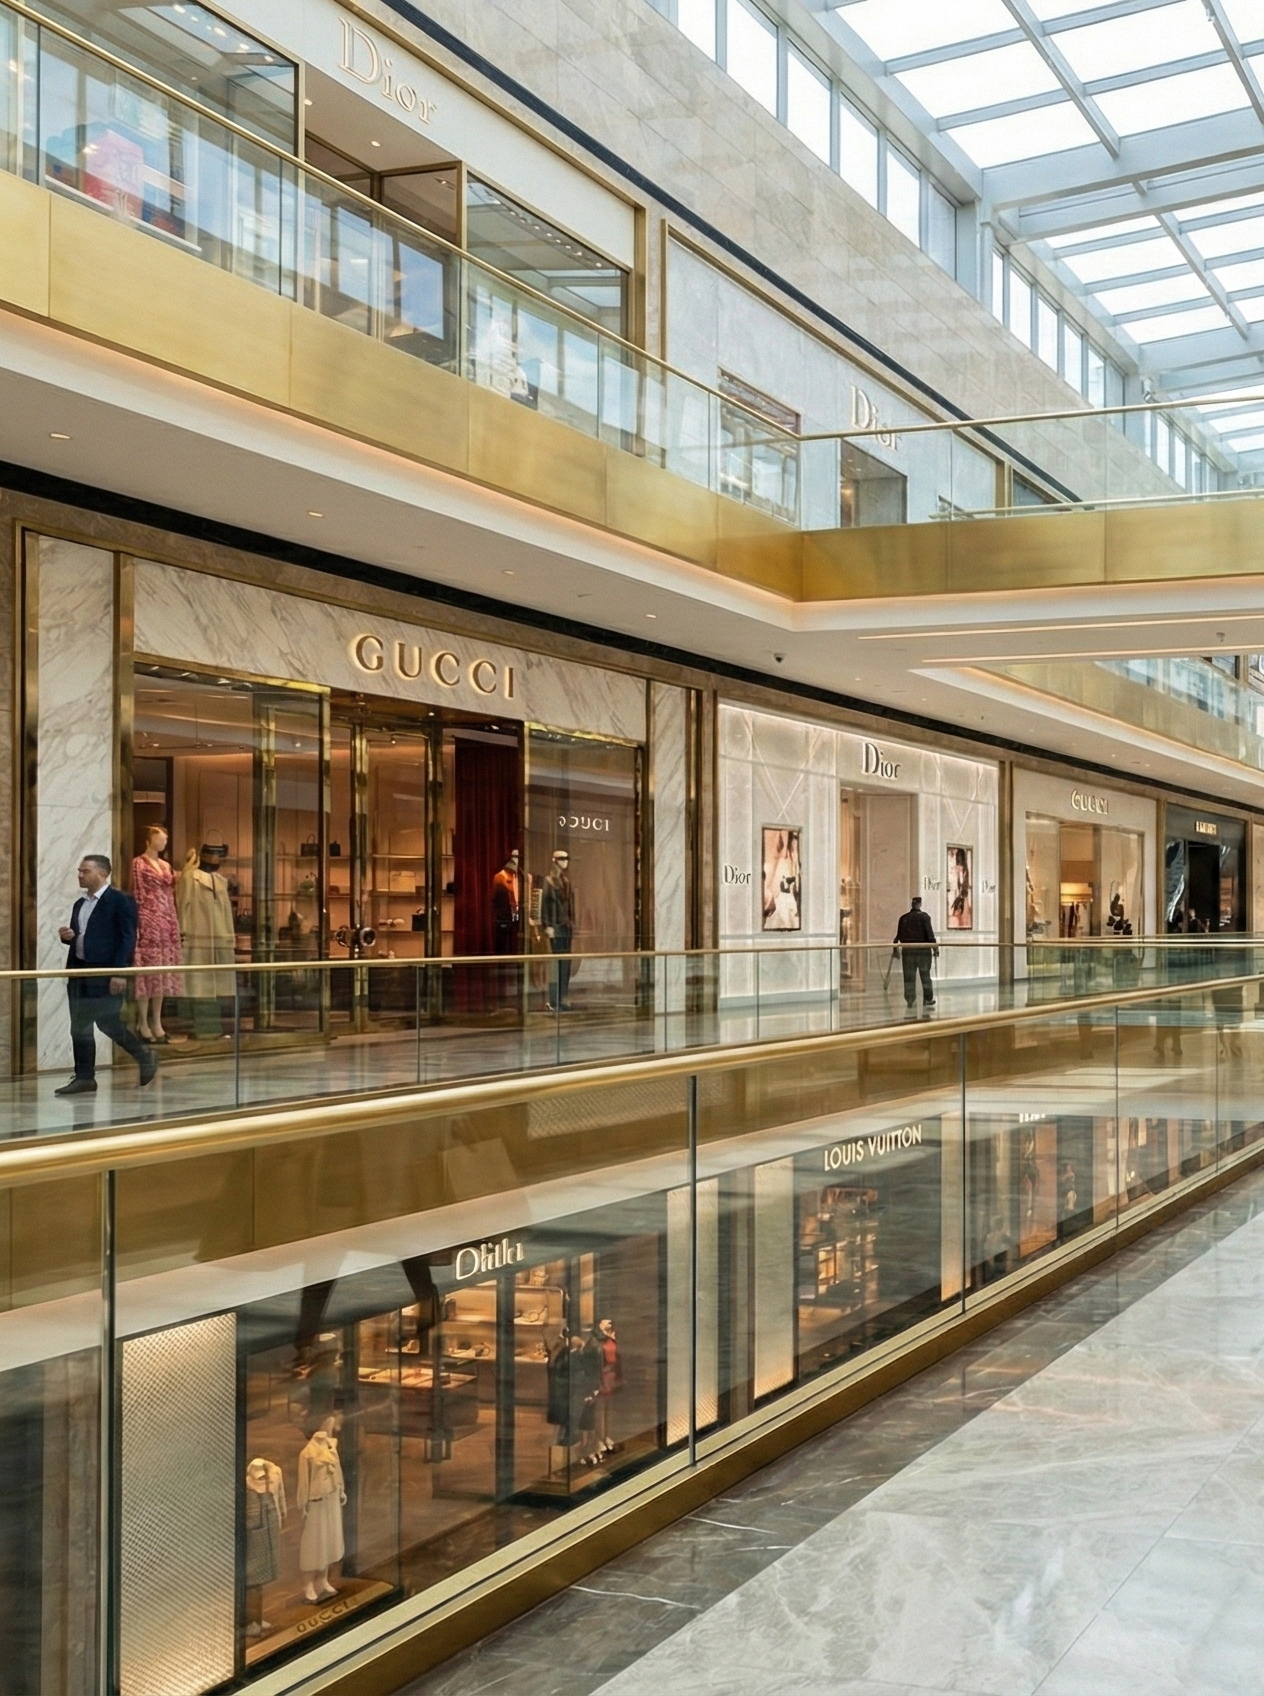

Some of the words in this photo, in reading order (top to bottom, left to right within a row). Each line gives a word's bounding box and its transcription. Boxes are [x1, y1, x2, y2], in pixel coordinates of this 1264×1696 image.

[338, 16, 437, 125] Dior
[353, 634, 514, 699] GUCCI
[862, 742, 901, 779] Dior
[723, 864, 751, 885] Dior
[824, 1140, 865, 1172] LOUIS
[867, 1123, 922, 1157] VUITTON
